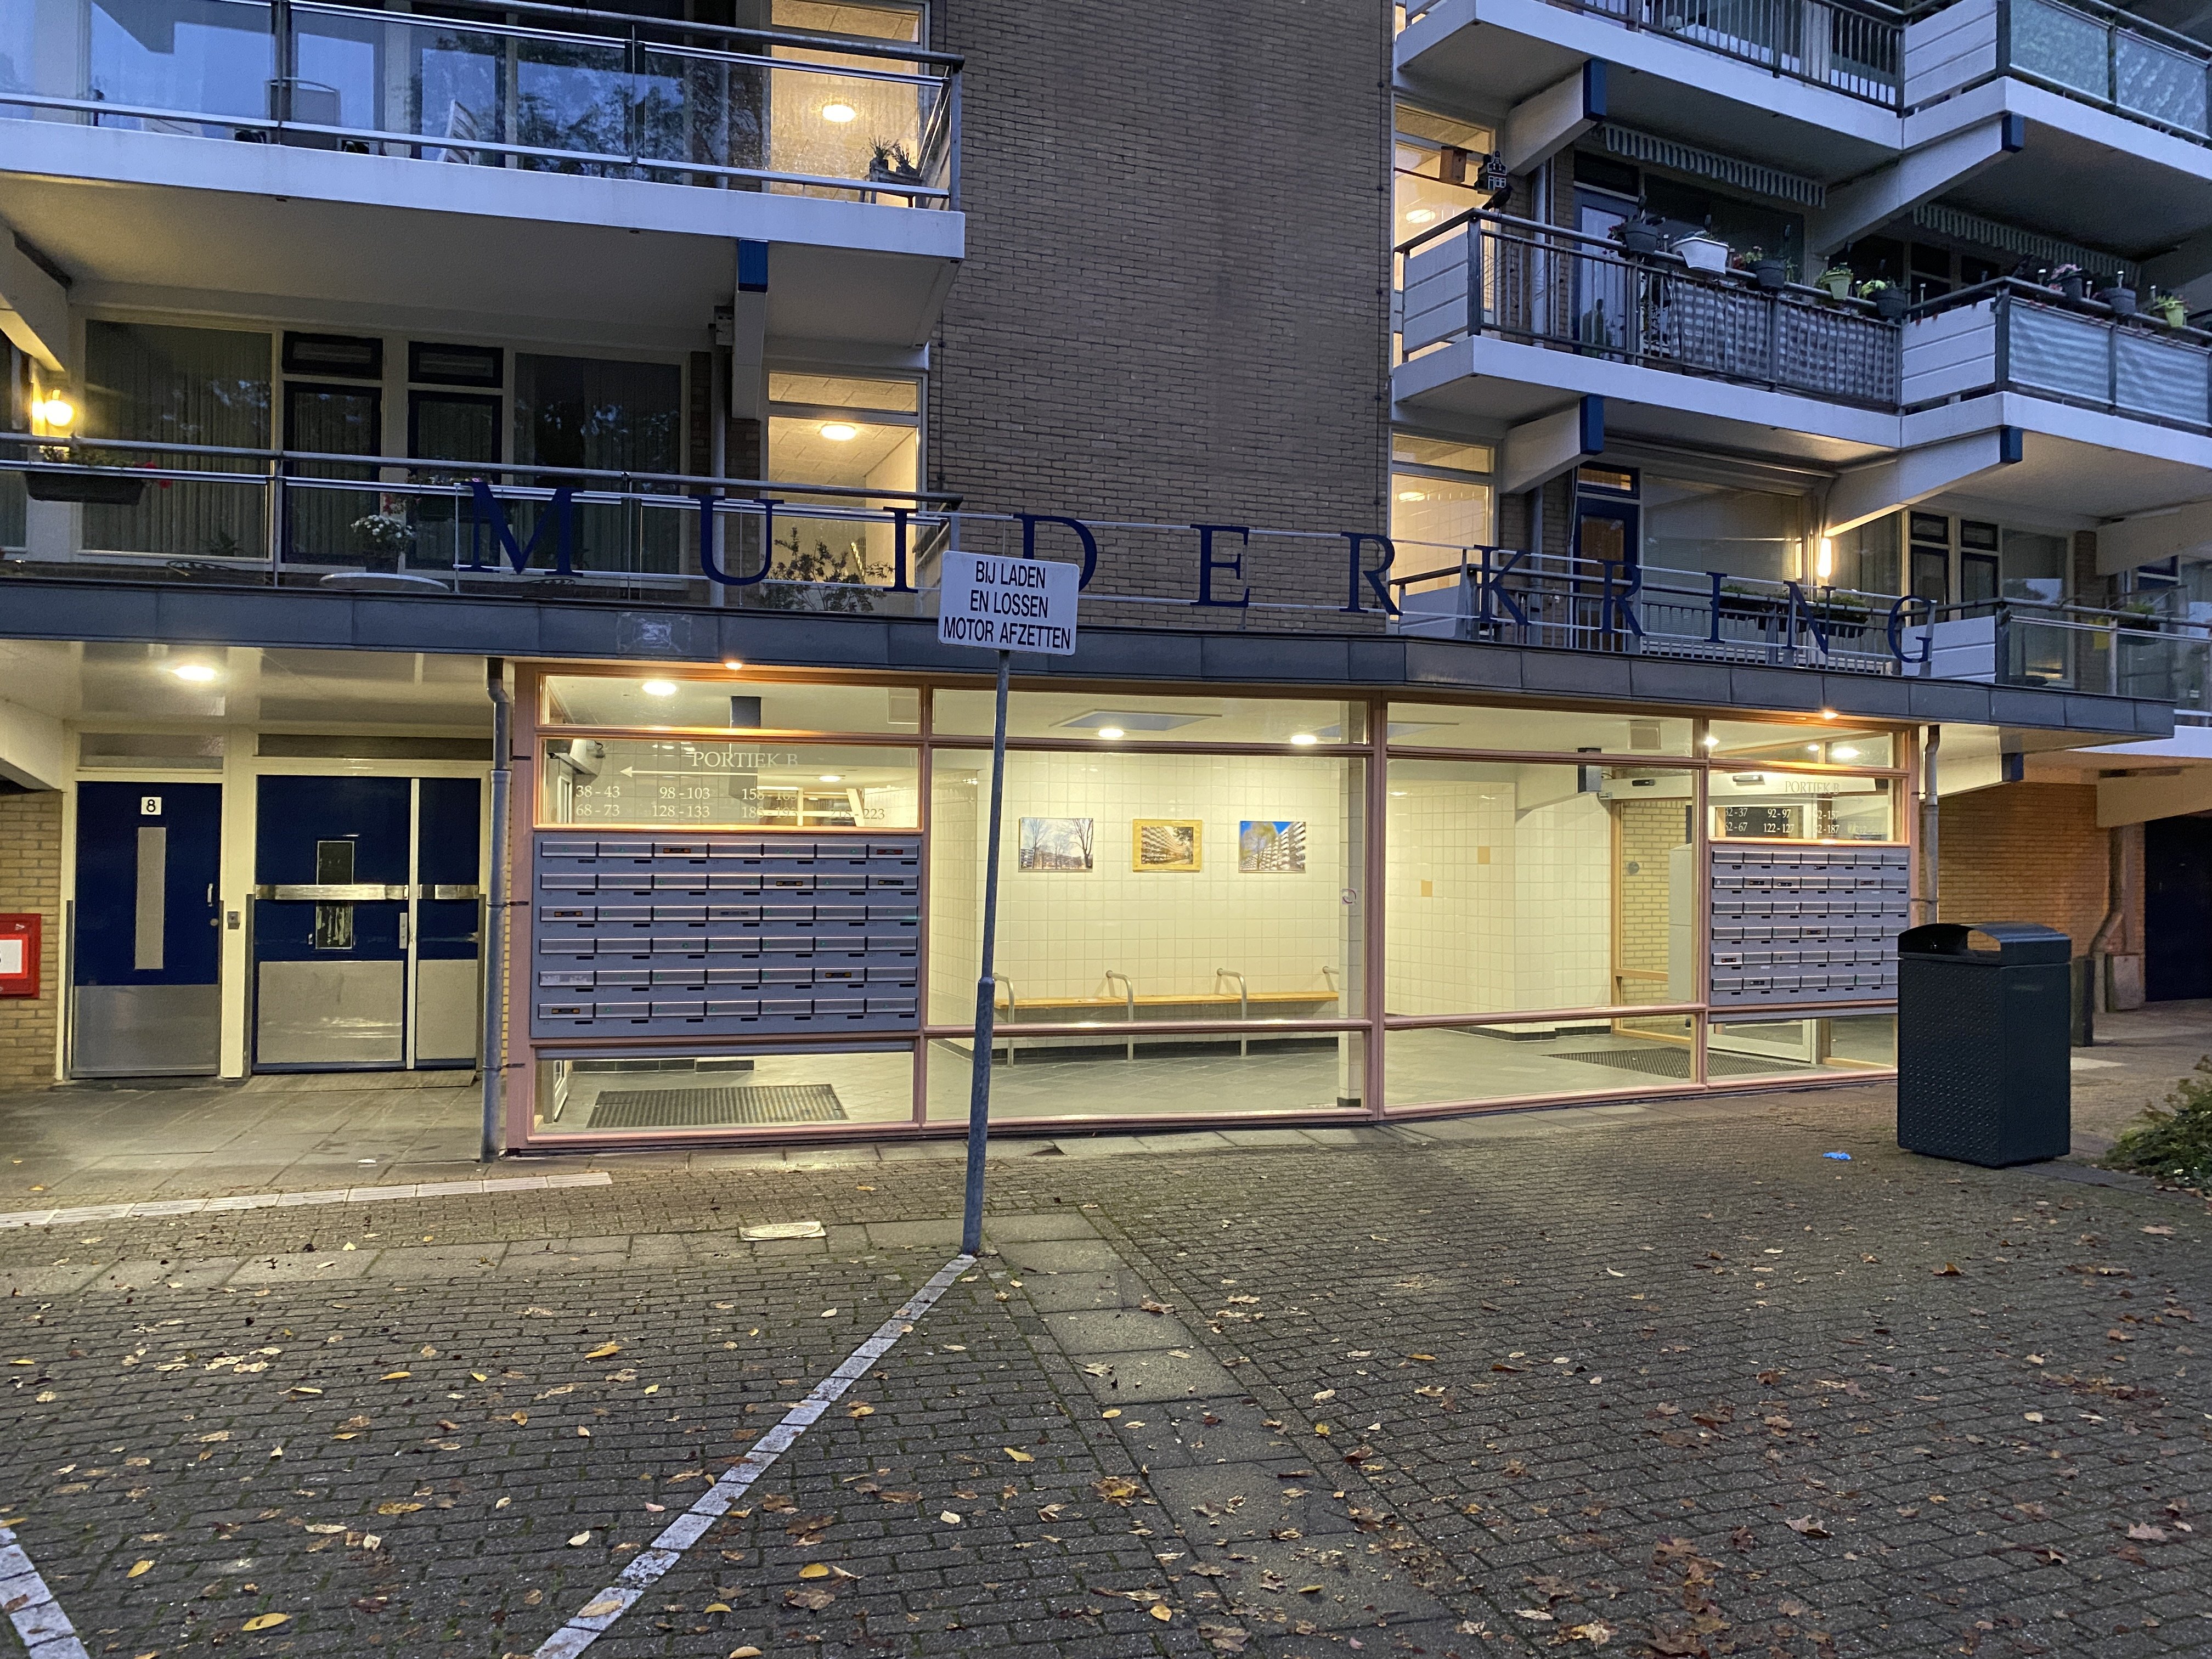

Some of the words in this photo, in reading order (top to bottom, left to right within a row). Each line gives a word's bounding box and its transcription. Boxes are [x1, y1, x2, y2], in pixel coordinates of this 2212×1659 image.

[975, 561, 996, 584] BIJ
[1000, 563, 1046, 589] LADEN
[970, 589, 989, 612] EN
[994, 591, 1048, 618] LOSSEN
[943, 616, 994, 642] MOTOR
[999, 622, 1071, 649] AFZETTEN
[691, 751, 781, 768] PORTIEK
[788, 753, 798, 768] B
[1785, 781, 1831, 794] PORTIEK
[1833, 783, 1839, 795] B
[146, 799, 156, 812] 8
